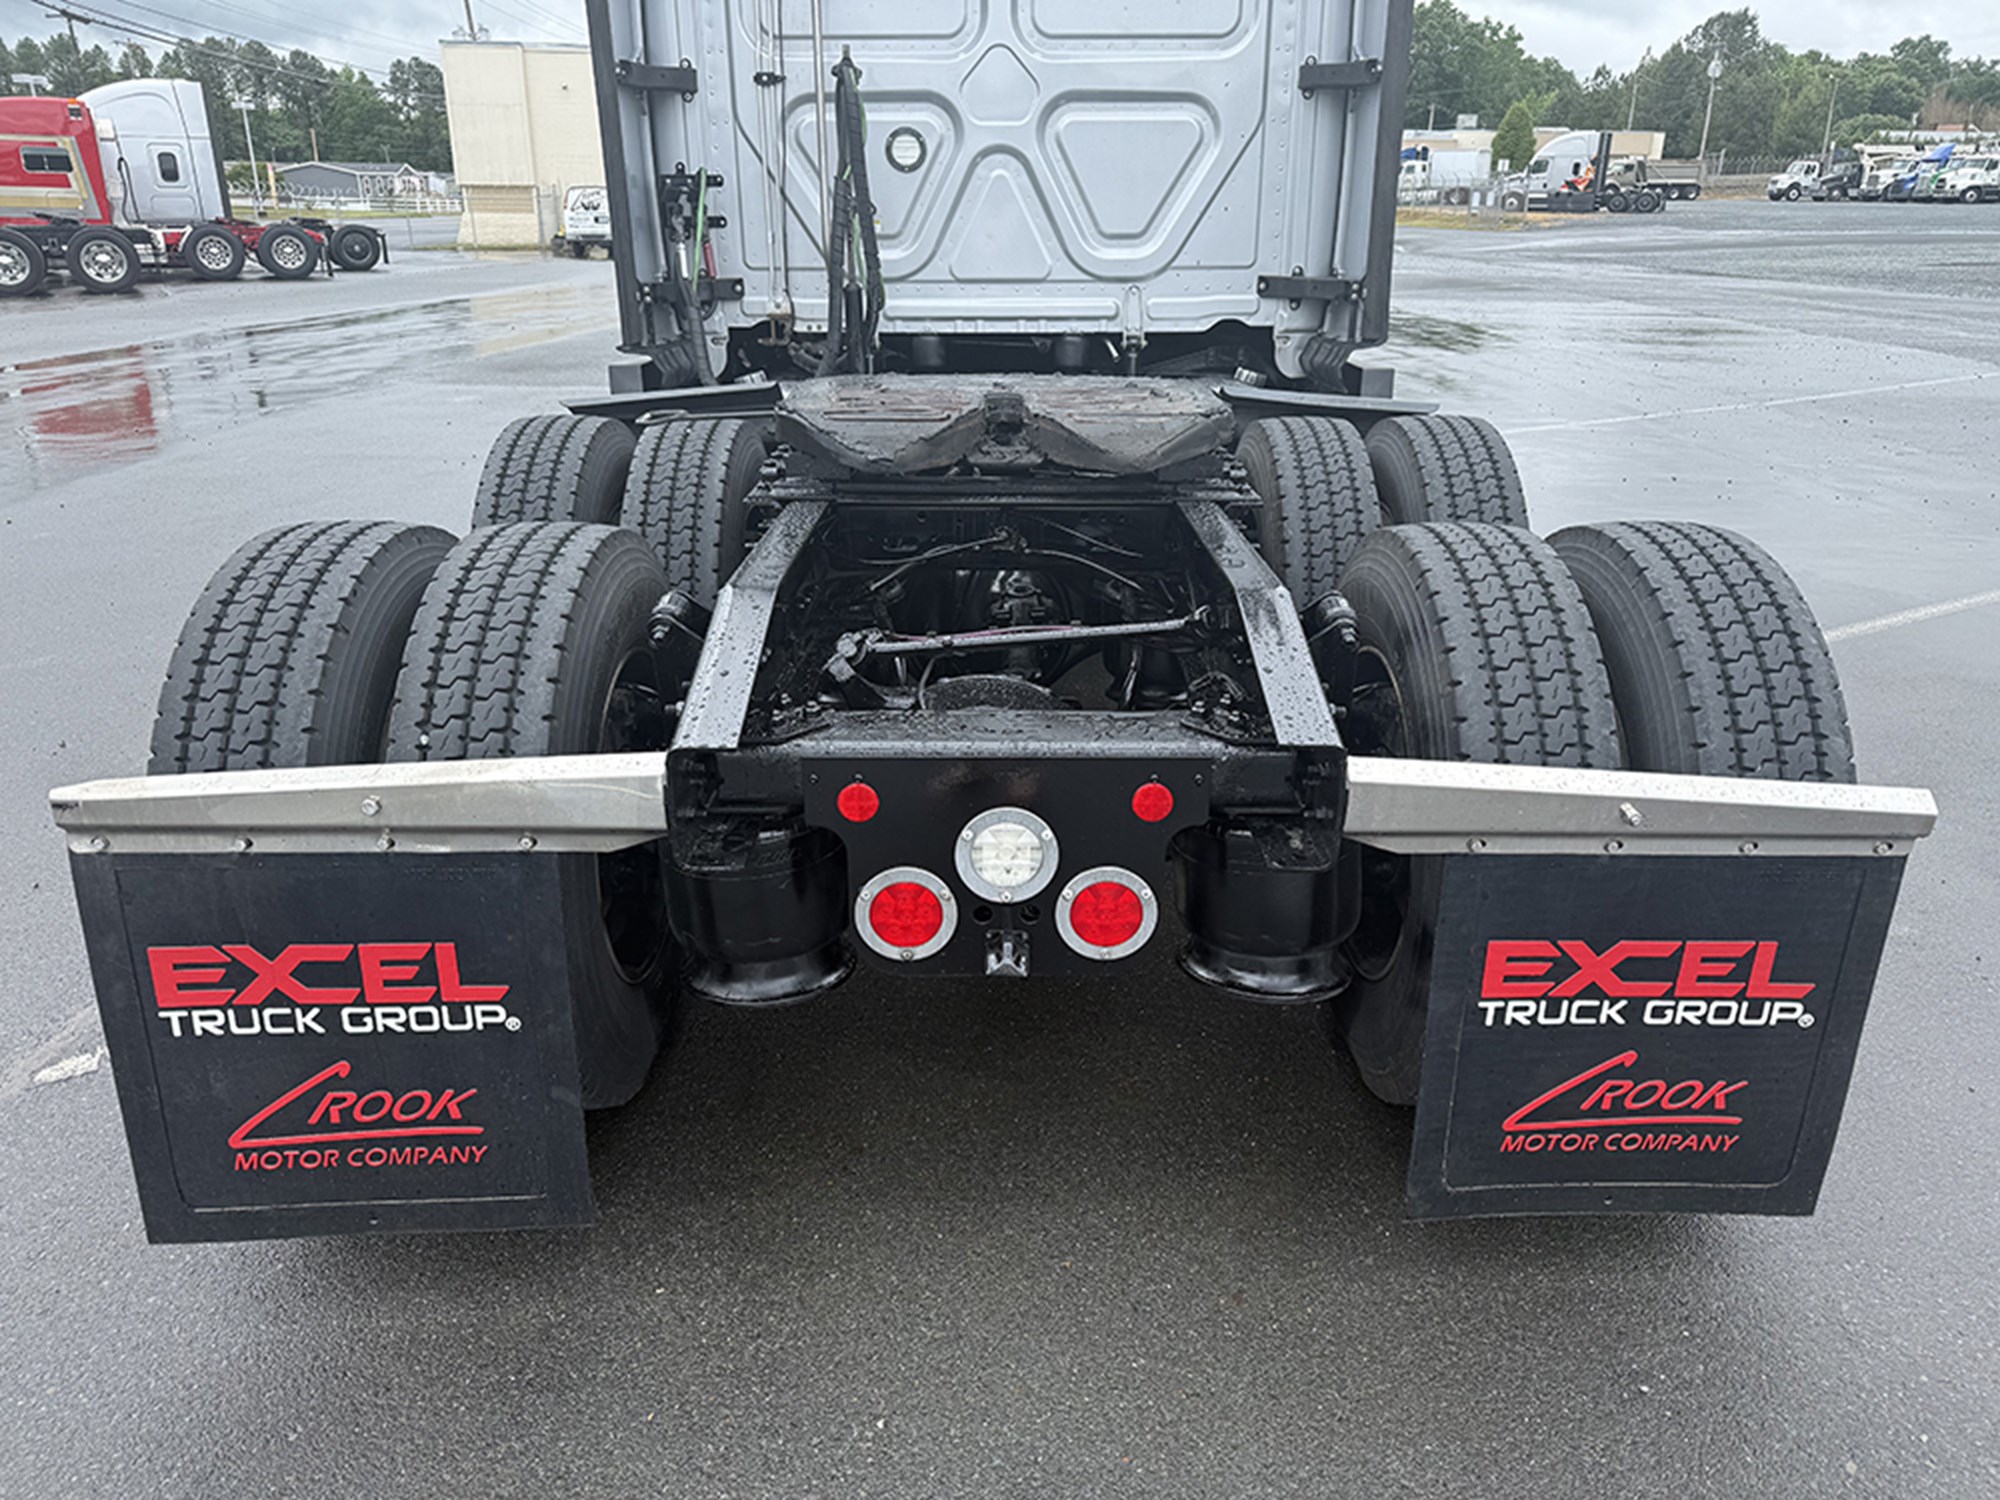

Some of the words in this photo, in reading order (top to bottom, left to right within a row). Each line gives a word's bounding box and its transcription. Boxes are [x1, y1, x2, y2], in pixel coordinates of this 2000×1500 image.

[147, 943, 510, 1005] EXCEL
[1481, 940, 1815, 998] EXCEL
[158, 1008, 325, 1037] TRUCK
[1478, 1000, 1628, 1026] TRUCK
[228, 1061, 486, 1149] CROOK
[1502, 1050, 1748, 1132] CROOK
[233, 1149, 340, 1171] MOTOR
[347, 1145, 488, 1168] COMPANY
[1500, 1134, 1599, 1152] MOTOR
[1604, 1134, 1740, 1152] COMPANY
